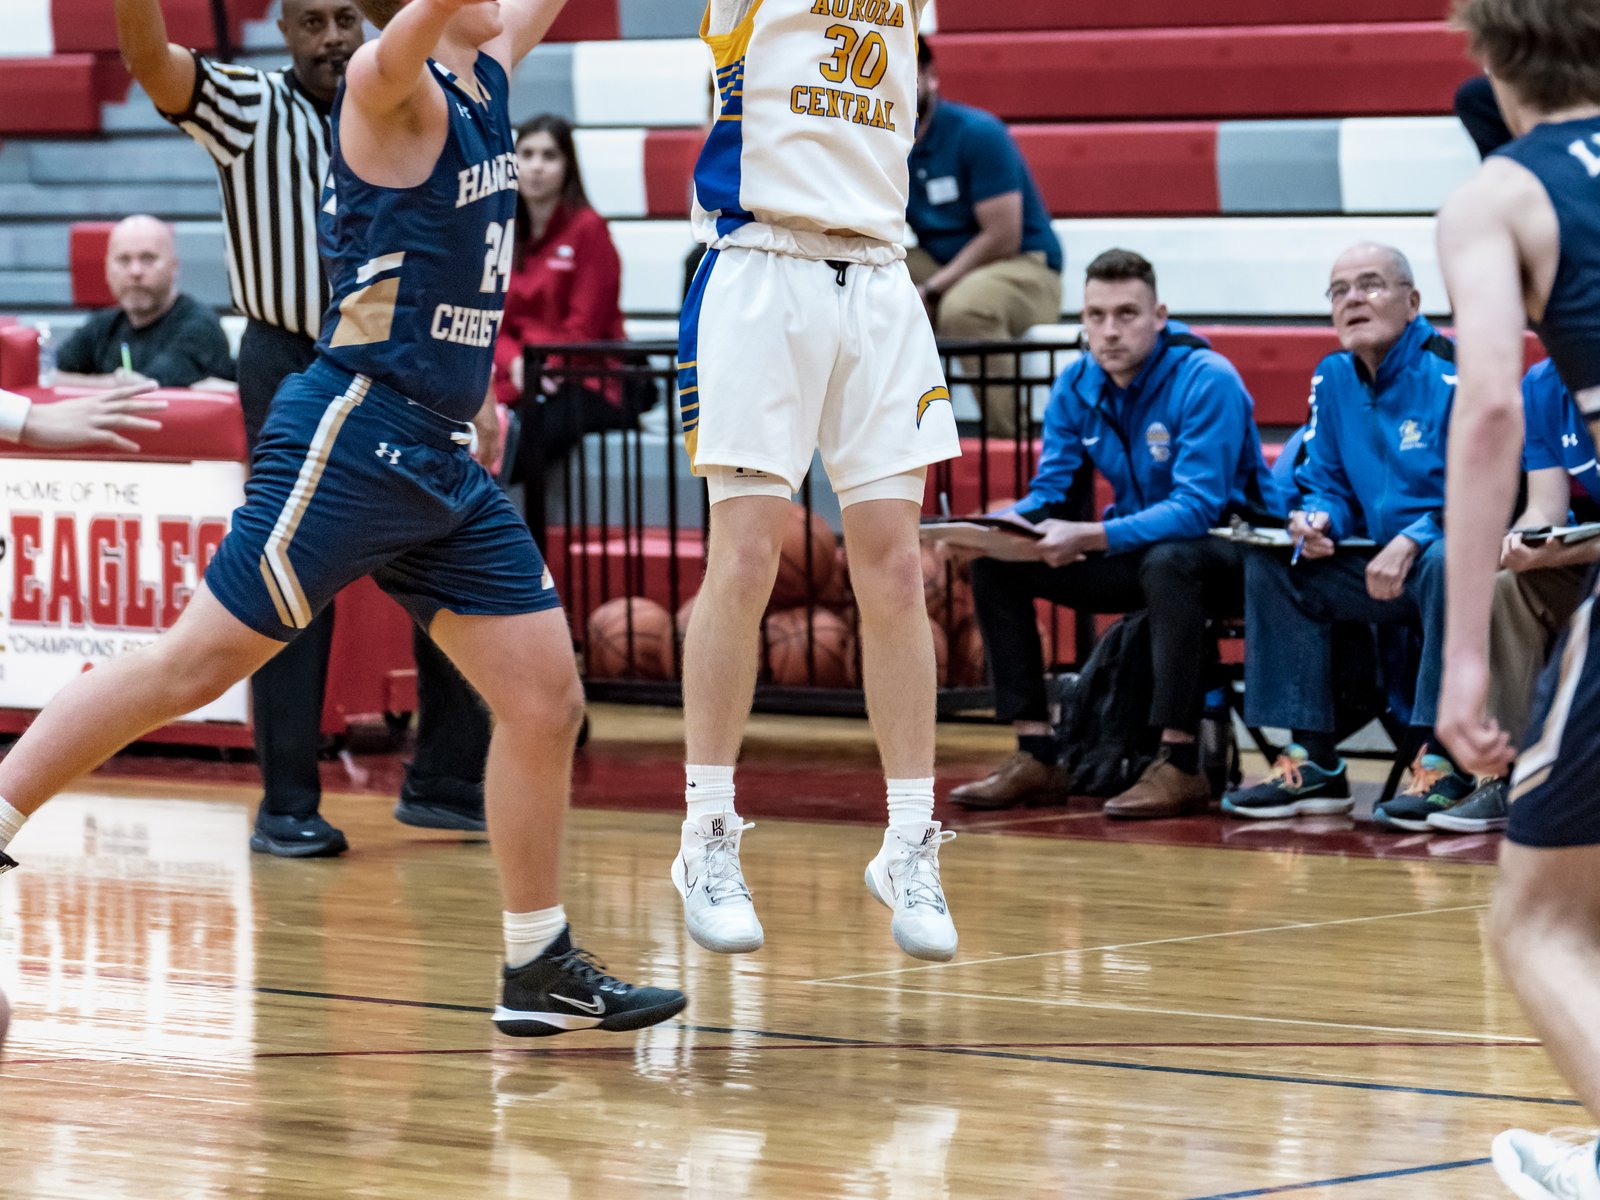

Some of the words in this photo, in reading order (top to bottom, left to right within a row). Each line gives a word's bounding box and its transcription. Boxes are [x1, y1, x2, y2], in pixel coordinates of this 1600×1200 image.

[819, 24, 888, 90] 30
[790, 85, 895, 132] CENTRAL
[479, 218, 515, 293] 24
[5, 480, 62, 502] HOME
[71, 481, 95, 503] OF
[104, 482, 139, 505] THE
